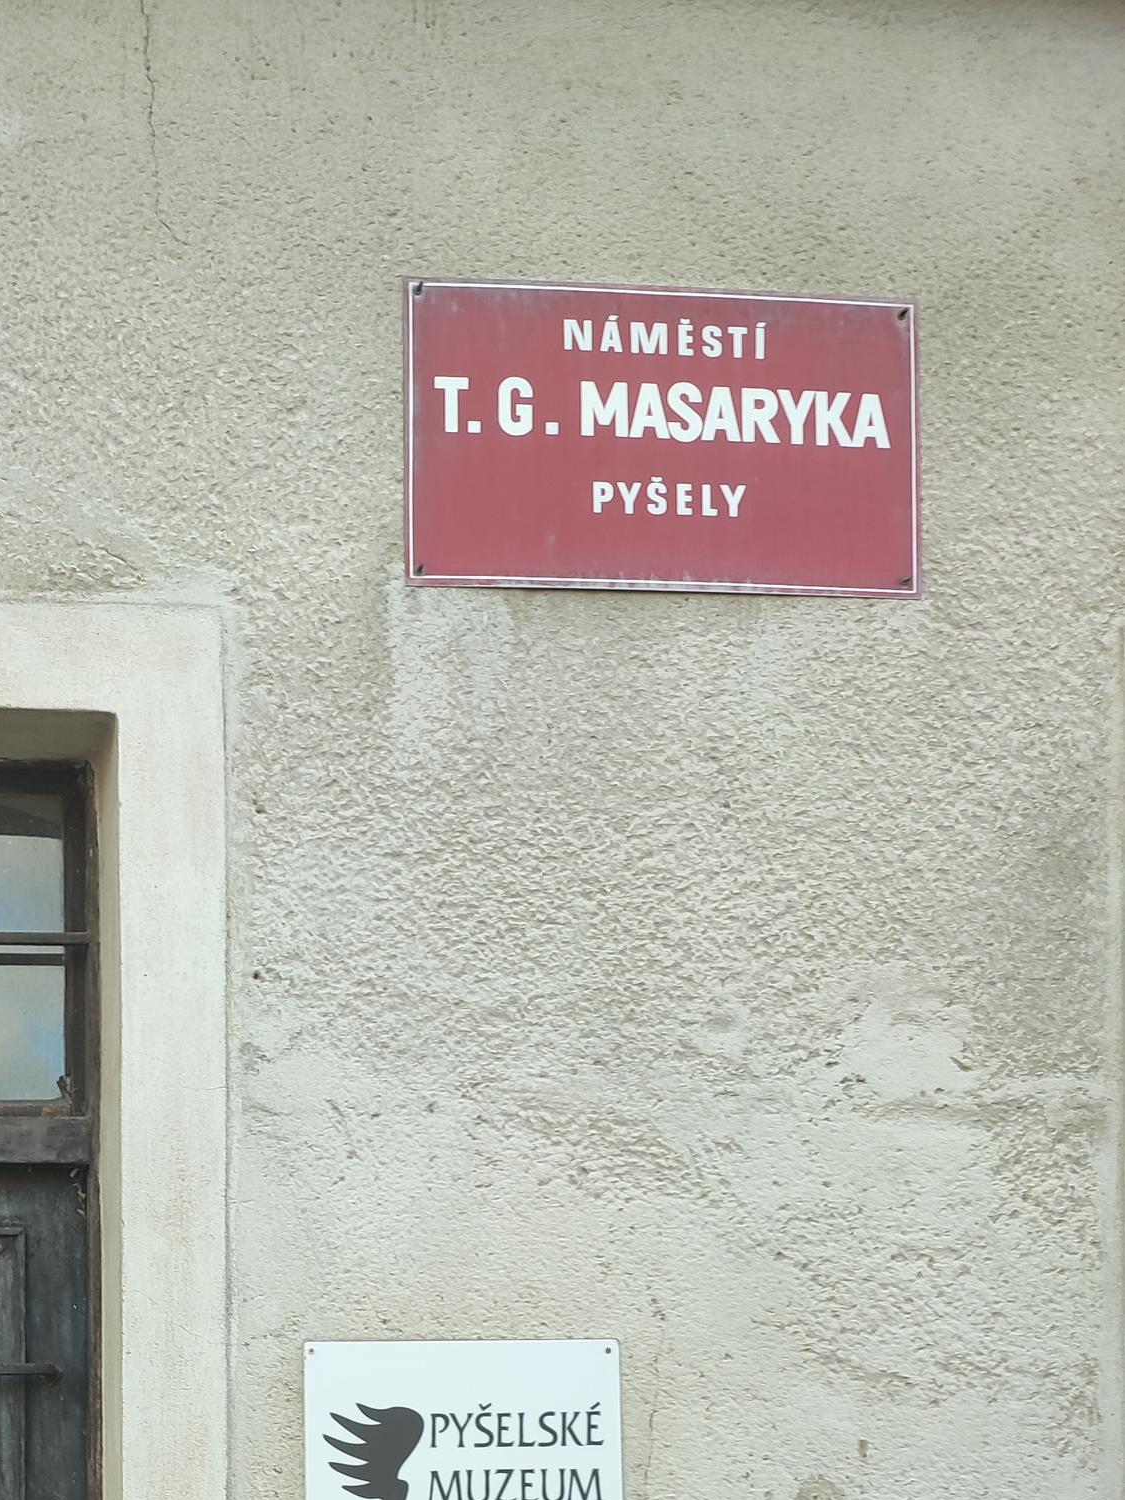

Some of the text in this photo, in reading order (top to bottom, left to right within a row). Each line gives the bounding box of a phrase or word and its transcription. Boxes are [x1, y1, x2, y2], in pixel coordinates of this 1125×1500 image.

[562, 315, 767, 360] NÁMĚSTÍ
[433, 375, 892, 450] T. G. MASARYKA
[591, 475, 748, 518] PYŠELY
[429, 1401, 605, 1449] PYŠELSKÉ
